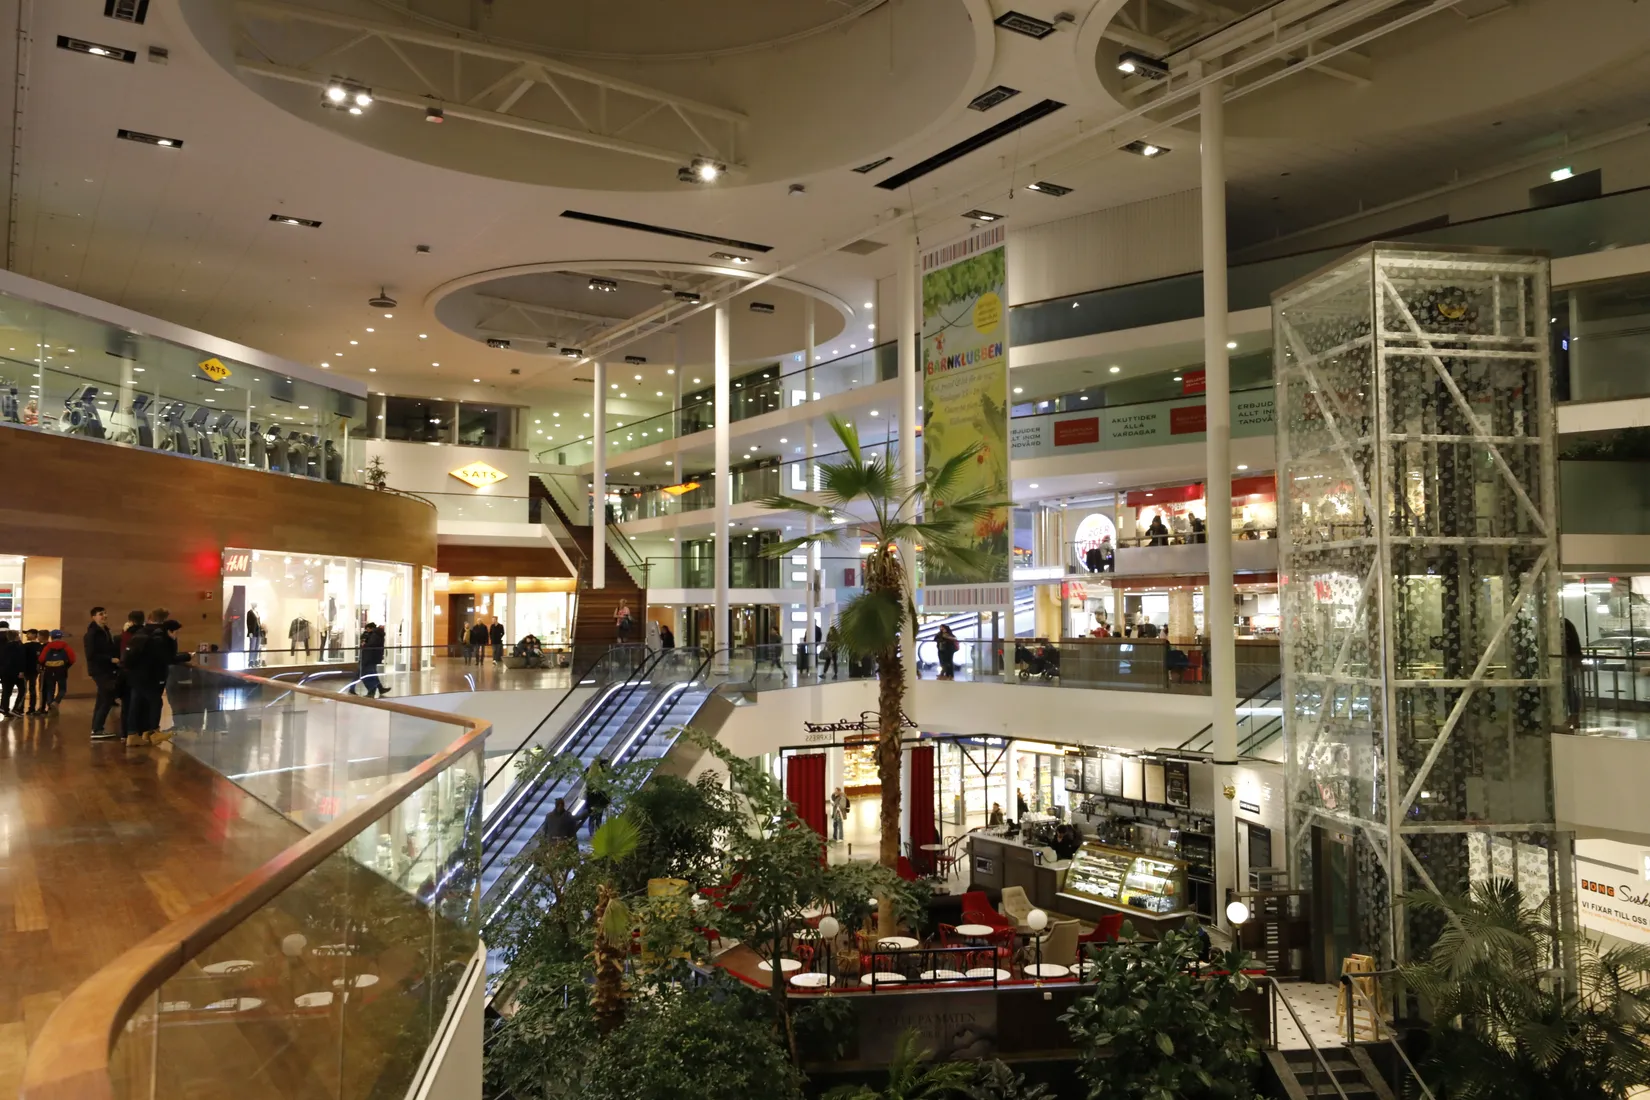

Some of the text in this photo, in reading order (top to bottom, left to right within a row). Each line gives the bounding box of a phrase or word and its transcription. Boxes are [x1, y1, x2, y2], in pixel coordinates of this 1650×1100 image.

[927, 342, 1003, 375] BARNKLUBBEN
[204, 363, 226, 375] SATS
[1237, 401, 1274, 410] ERBJUD
[1112, 414, 1157, 424] AKUTTIDER
[1238, 415, 1274, 425] TANDVÅ
[1011, 427, 1041, 435] BJUDER
[1112, 428, 1157, 438] VARDAGAR
[1011, 440, 1041, 448] NDVÅRD
[462, 470, 497, 479] SATS
[226, 554, 249, 572] H&M
[1581, 879, 1615, 897] PONG
[1591, 904, 1612, 915] FIXAR
[1614, 910, 1630, 920] TILL
[1632, 915, 1648, 925] OSS
